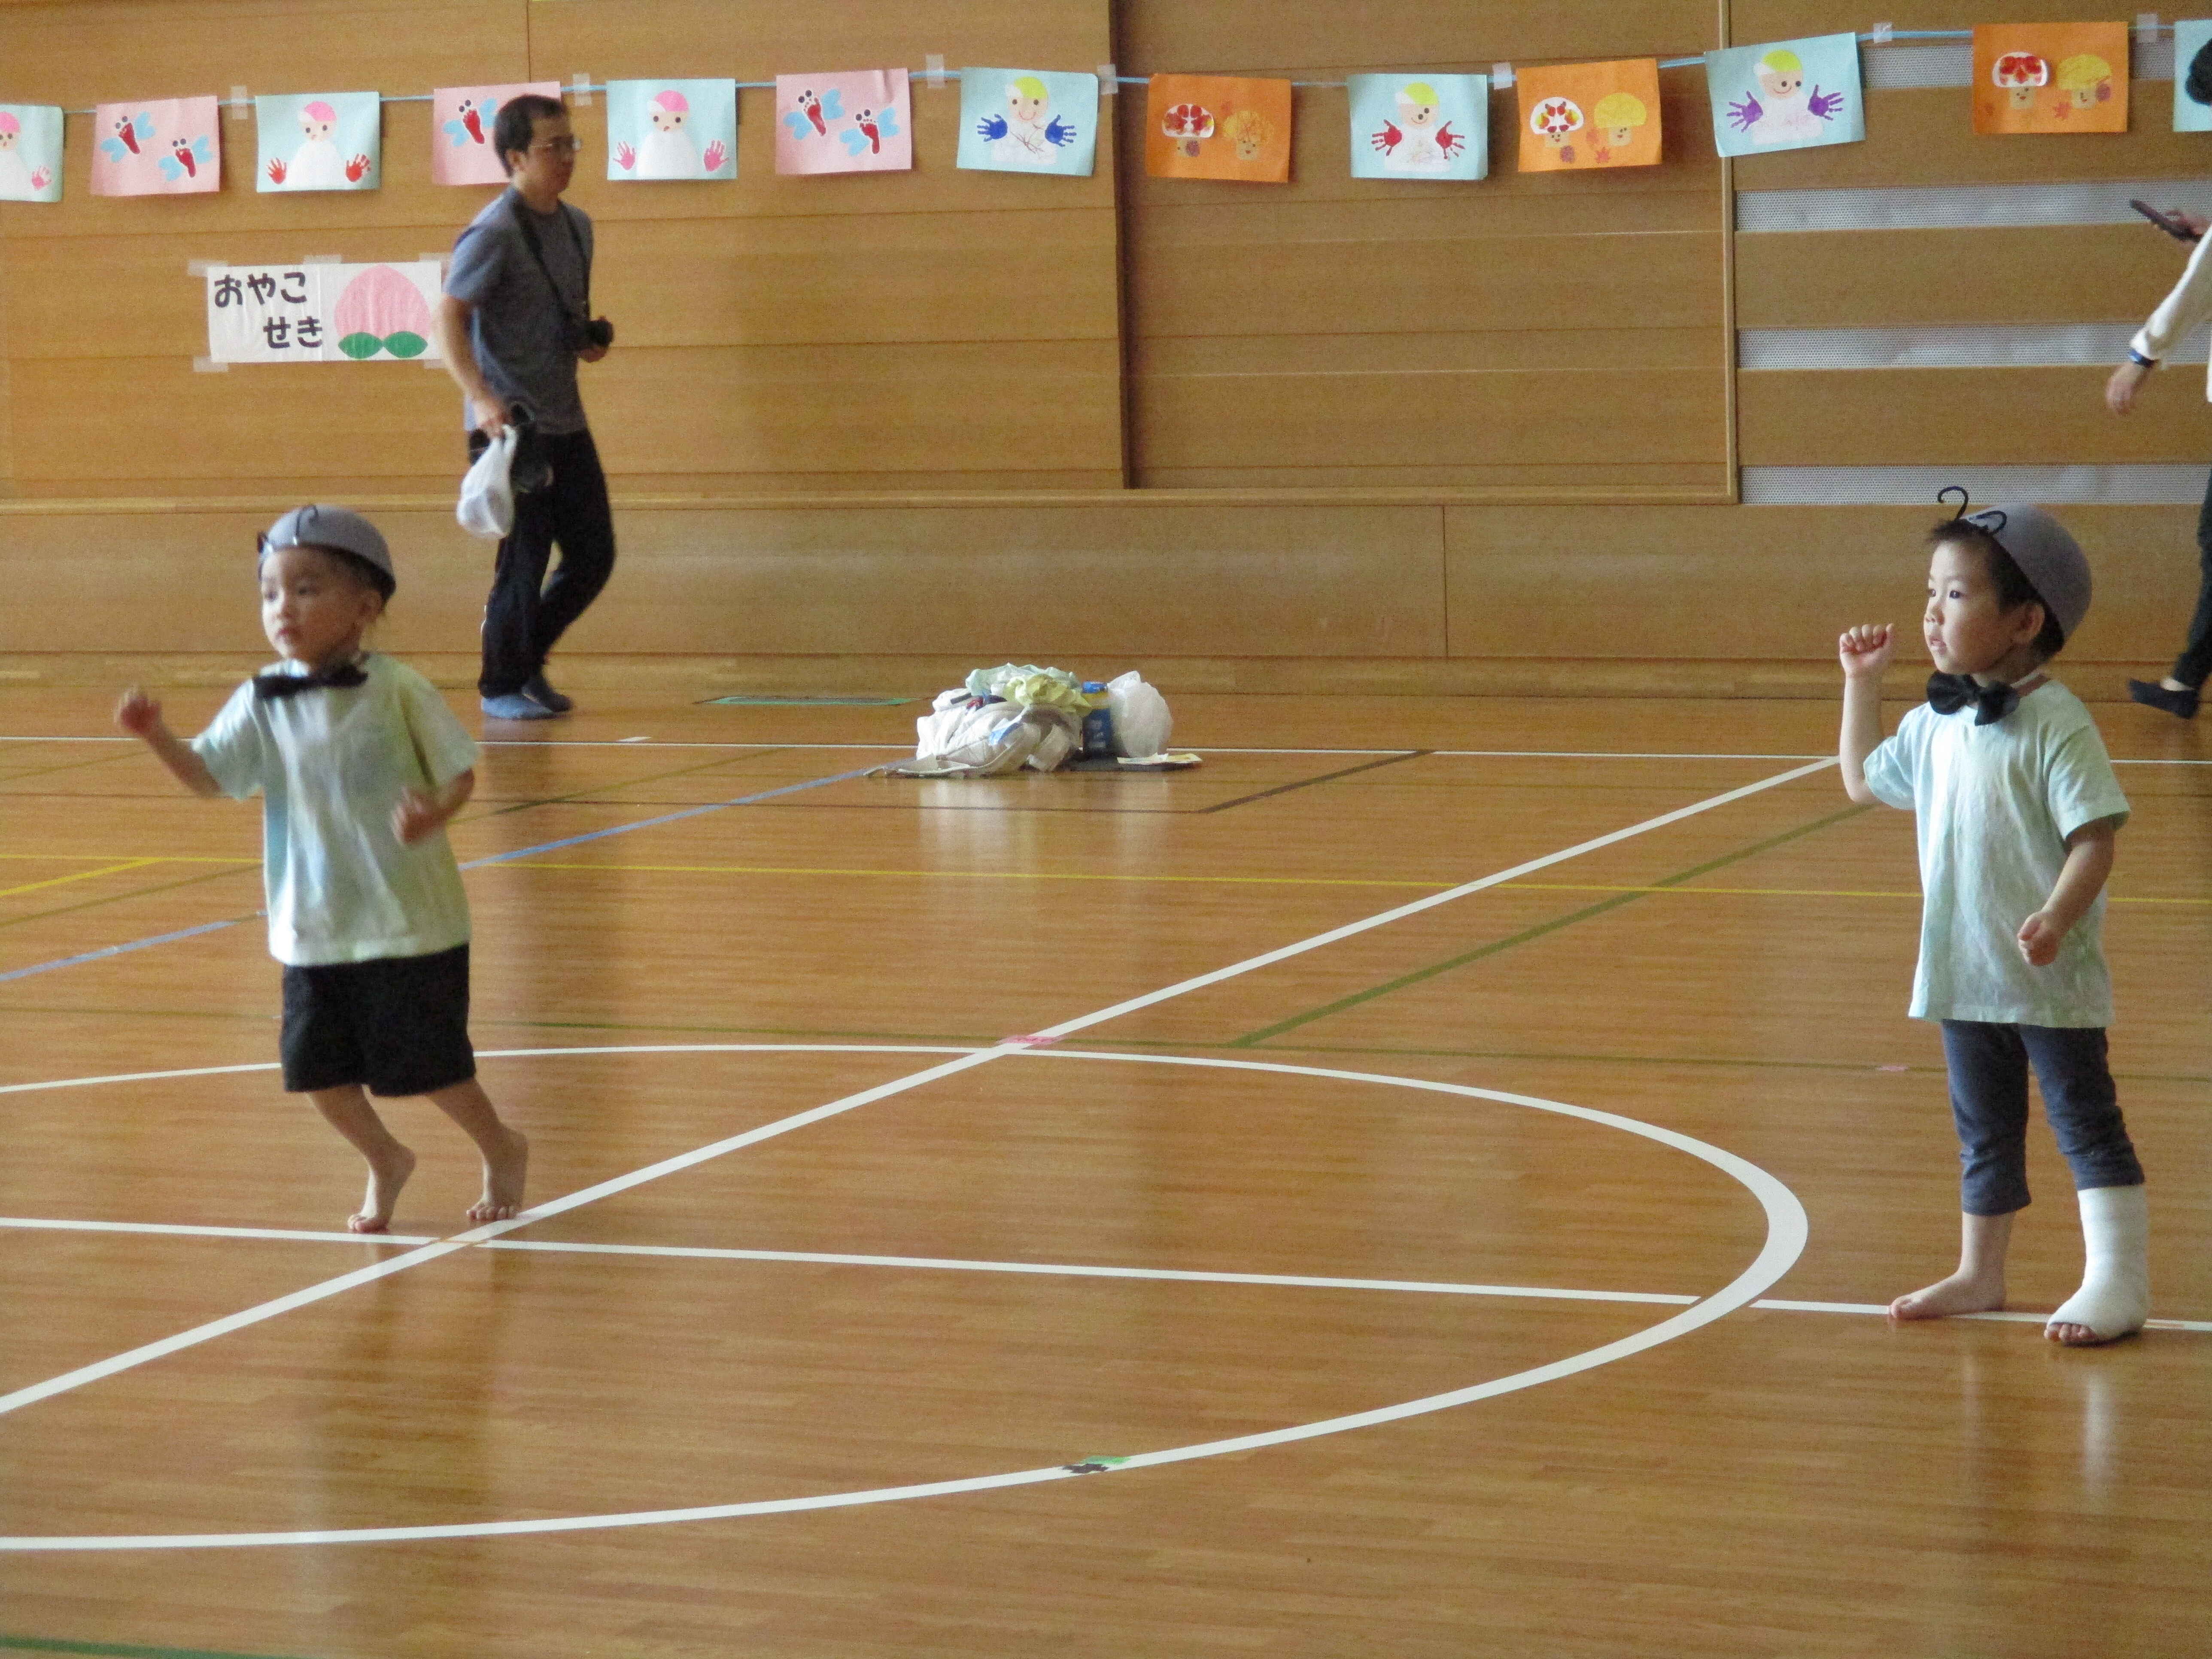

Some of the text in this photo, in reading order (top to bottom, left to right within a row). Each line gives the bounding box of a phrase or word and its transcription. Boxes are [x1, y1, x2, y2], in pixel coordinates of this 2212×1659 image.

[214, 272, 307, 308] おやこ
[263, 316, 323, 349] せき
